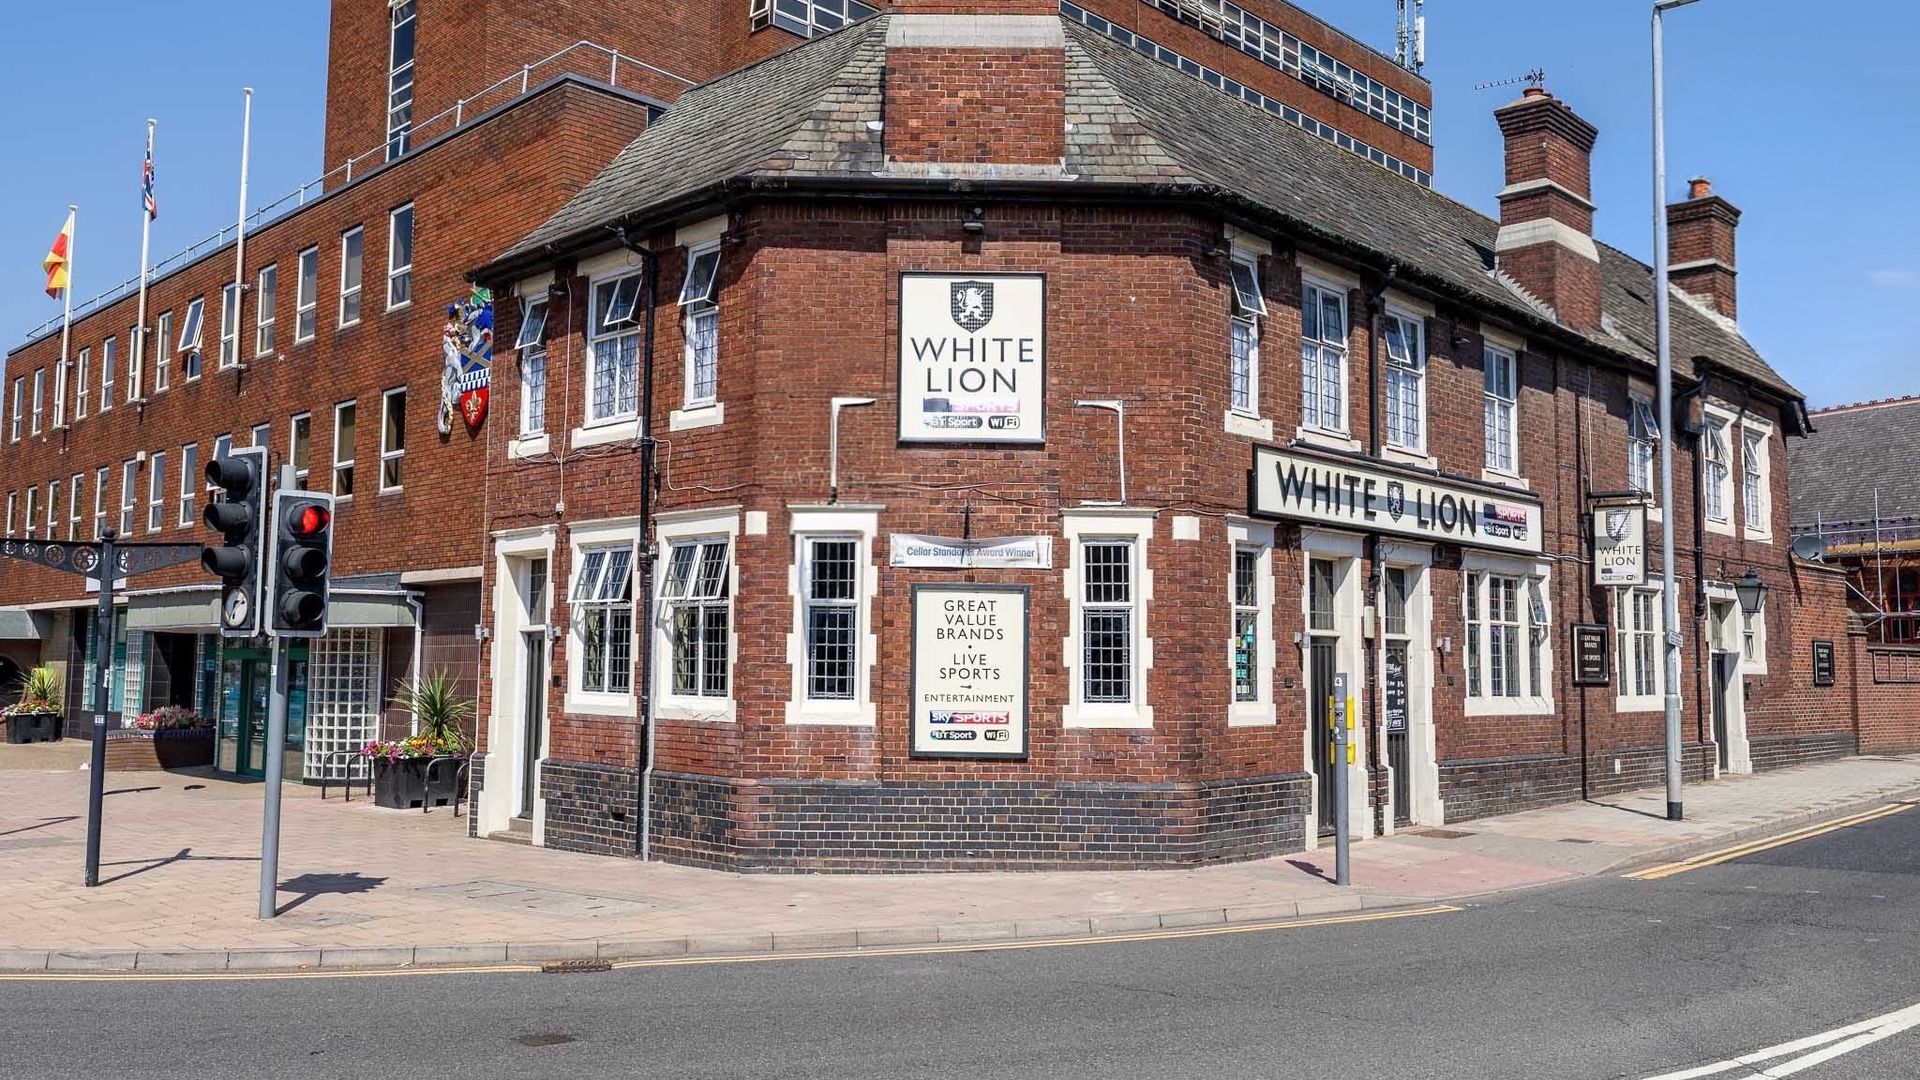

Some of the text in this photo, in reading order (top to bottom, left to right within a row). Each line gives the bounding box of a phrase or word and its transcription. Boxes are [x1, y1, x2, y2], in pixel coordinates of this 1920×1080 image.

[911, 337, 1034, 363] WHITE
[927, 367, 1016, 393] LION
[947, 417, 978, 428] Sport
[1275, 460, 1476, 537] WHITE LION
[1495, 525, 1509, 537] Sport
[907, 547, 1035, 557] Cellar Standards Award Winner
[1599, 545, 1641, 555] WHITE
[1604, 556, 1635, 566] LION
[944, 600, 998, 612] GREAT
[945, 614, 997, 626] VALUE
[936, 628, 1004, 640] BRANDS
[953, 654, 987, 665] LIVE
[939, 668, 1001, 680] SPORTS
[924, 693, 1015, 703] ENTERTAINMENT
[954, 712, 1007, 723] SPORTS
[949, 731, 973, 740] Sport
